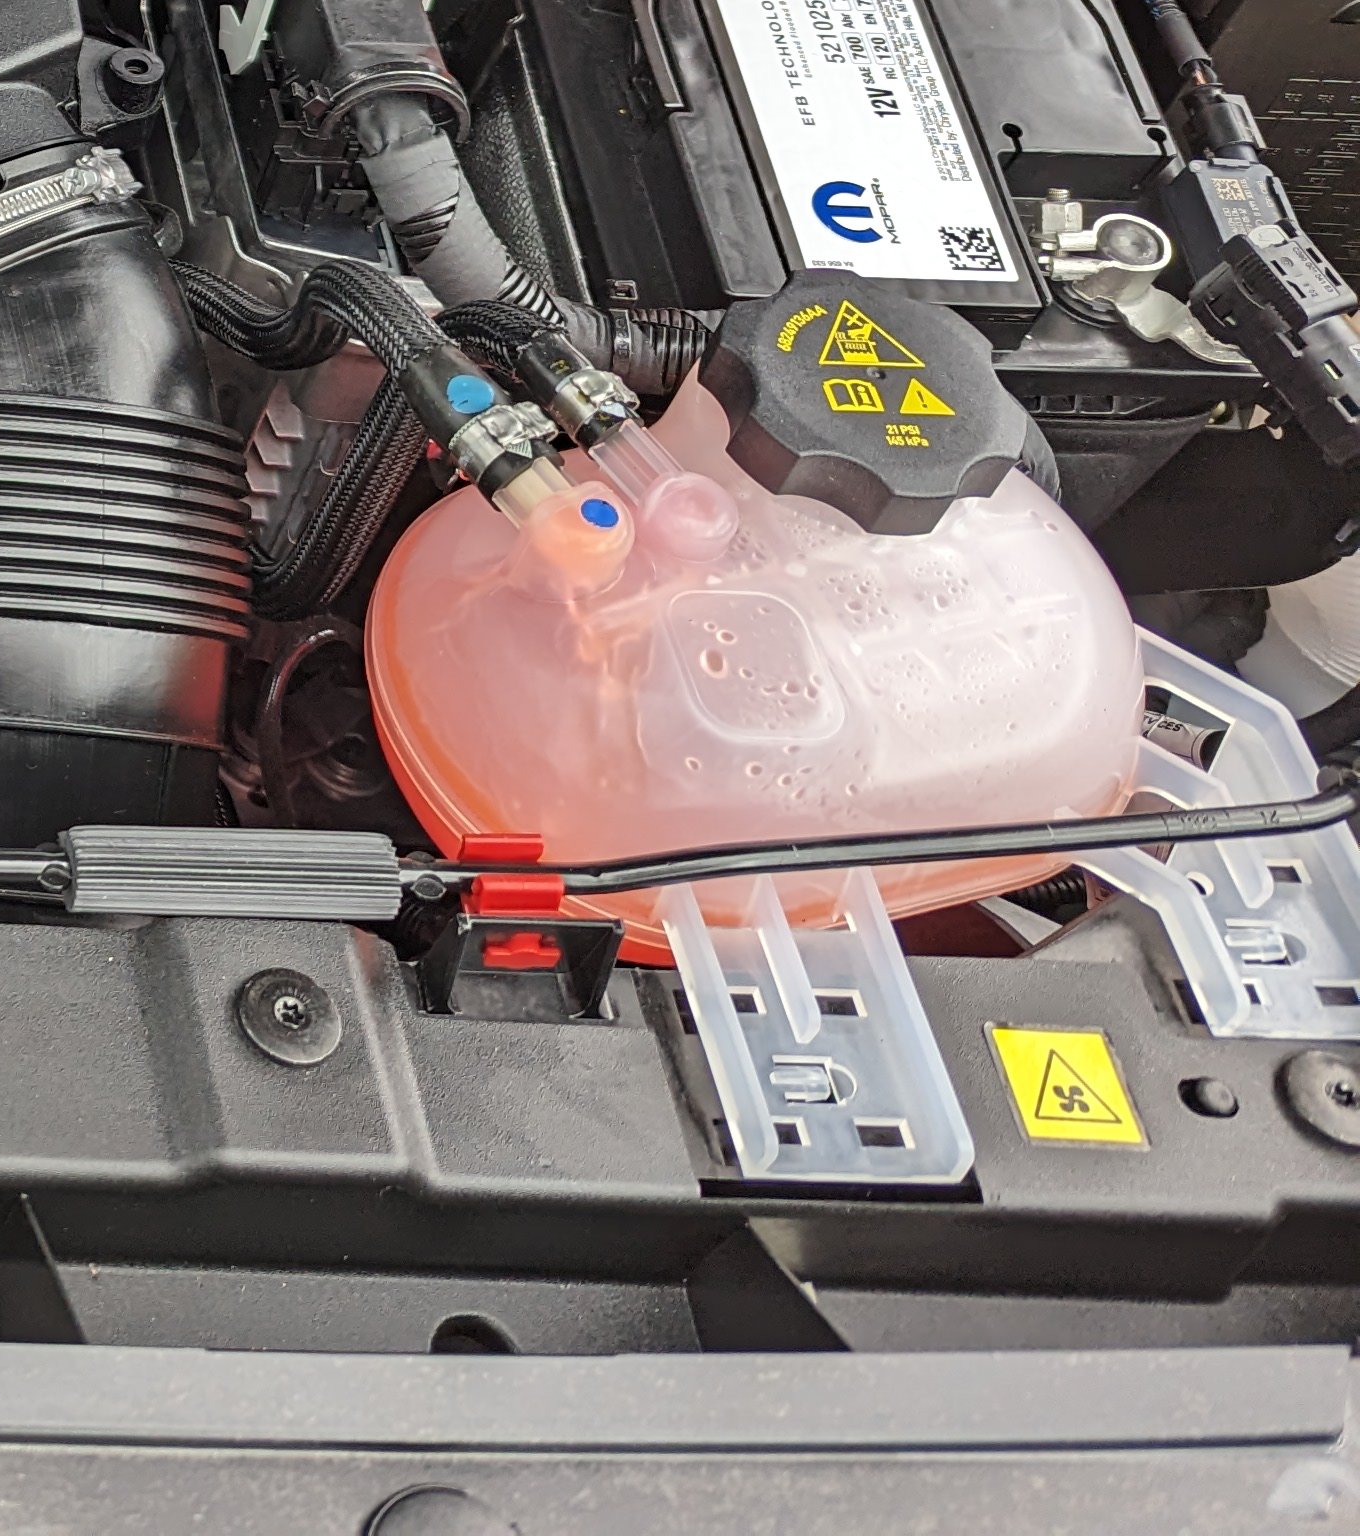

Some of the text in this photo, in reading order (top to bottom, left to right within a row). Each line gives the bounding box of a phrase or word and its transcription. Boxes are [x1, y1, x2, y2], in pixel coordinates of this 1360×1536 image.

[838, 12, 856, 28] Ahr
[861, 12, 878, 25] EN
[845, 35, 868, 60] 700
[869, 36, 892, 60] 120
[857, 65, 876, 84] SAE
[880, 66, 898, 79] RC
[923, 75, 941, 97] Group
[793, 94, 816, 126] EFB
[864, 86, 903, 119] 12V
[932, 98, 955, 128] Chrysler
[948, 142, 973, 181] Distributed
[886, 424, 920, 436] 21 PSI
[907, 436, 929, 448] kPa
